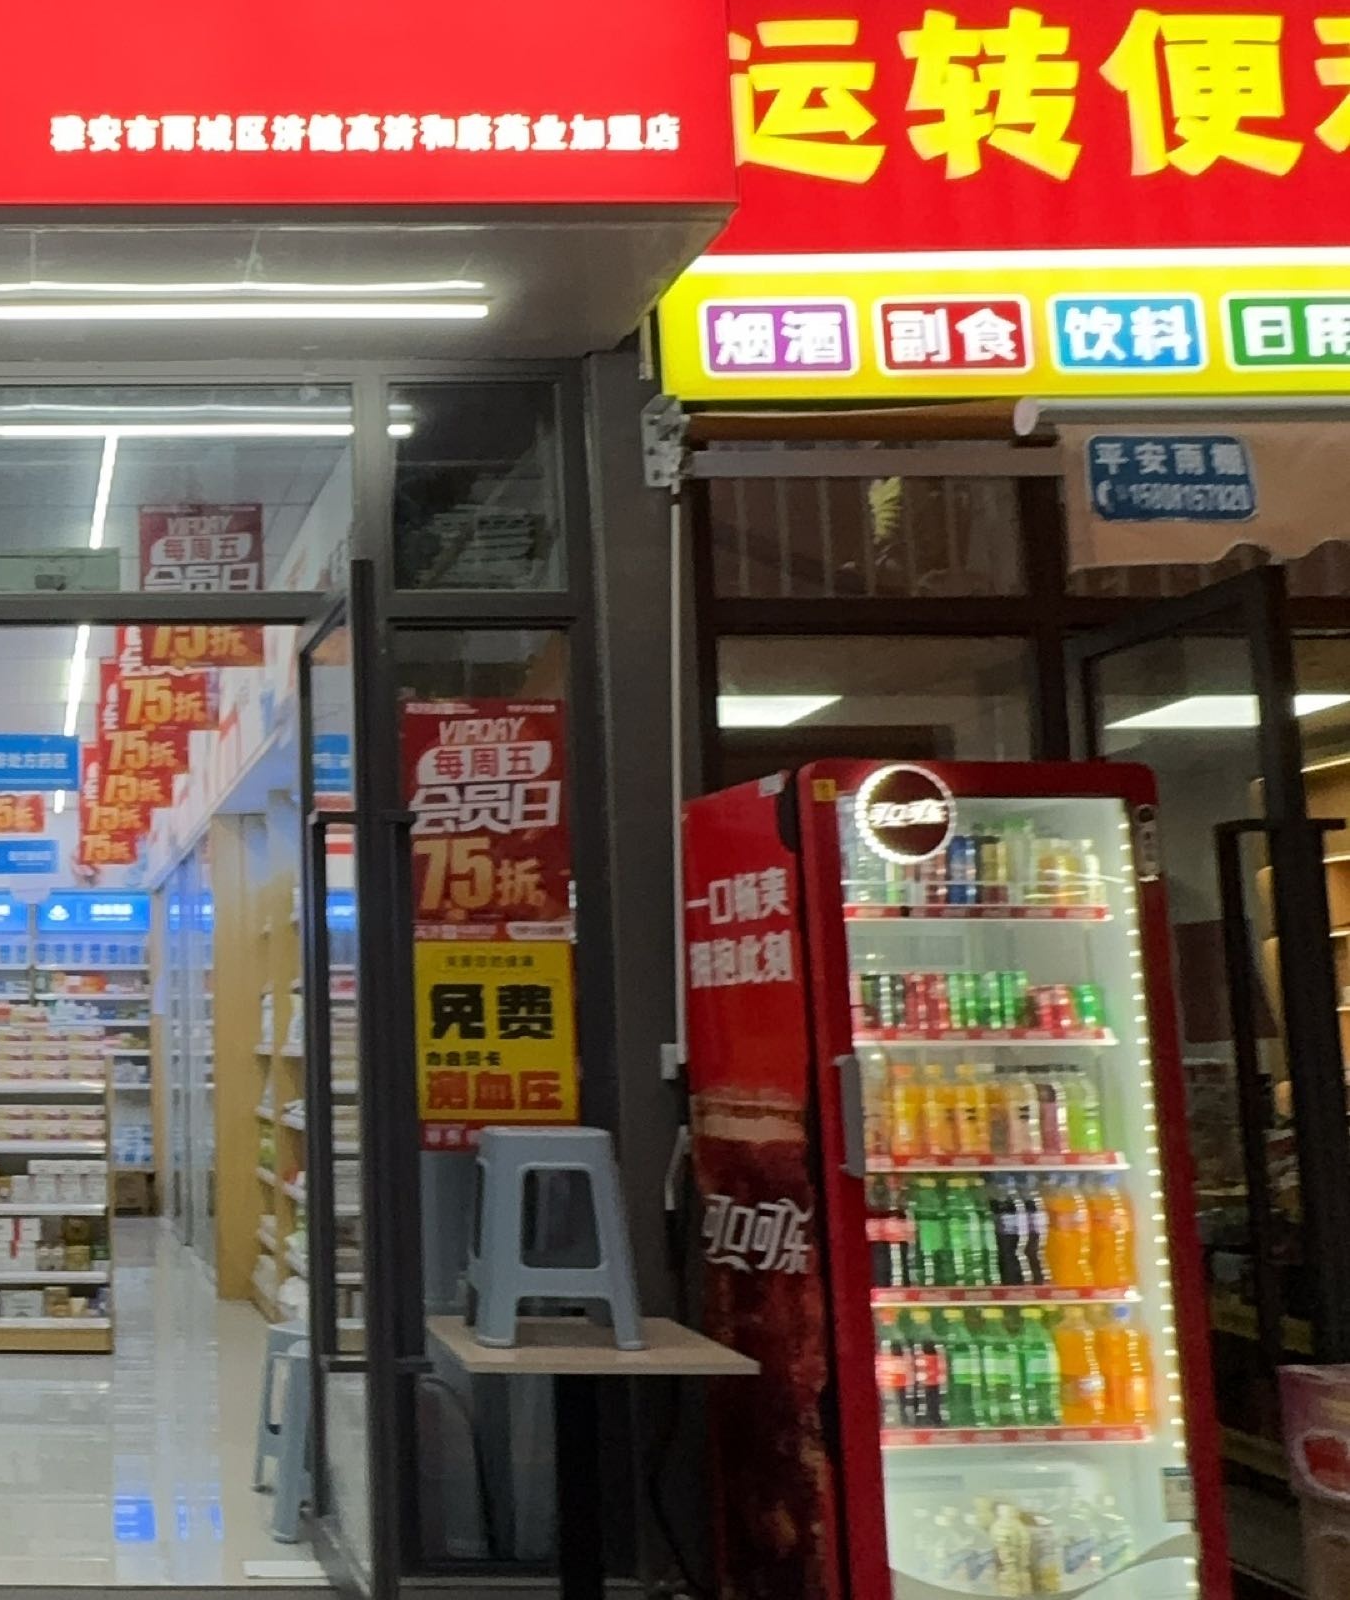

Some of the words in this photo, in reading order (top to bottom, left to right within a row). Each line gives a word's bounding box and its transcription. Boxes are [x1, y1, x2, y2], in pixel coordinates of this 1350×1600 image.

[729, 7, 1350, 184] 运转便
[714, 309, 844, 367] 烟酒
[888, 306, 1018, 361] 副食
[1063, 304, 1192, 361] 饮料
[164, 537, 240, 561] 每周五
[122, 678, 206, 725] 75折
[434, 746, 534, 778] 每周五
[408, 781, 562, 834] 会员日
[412, 837, 547, 910] 75折
[430, 984, 554, 1039] 免费
[700, 1194, 814, 1275] 可口可乐
